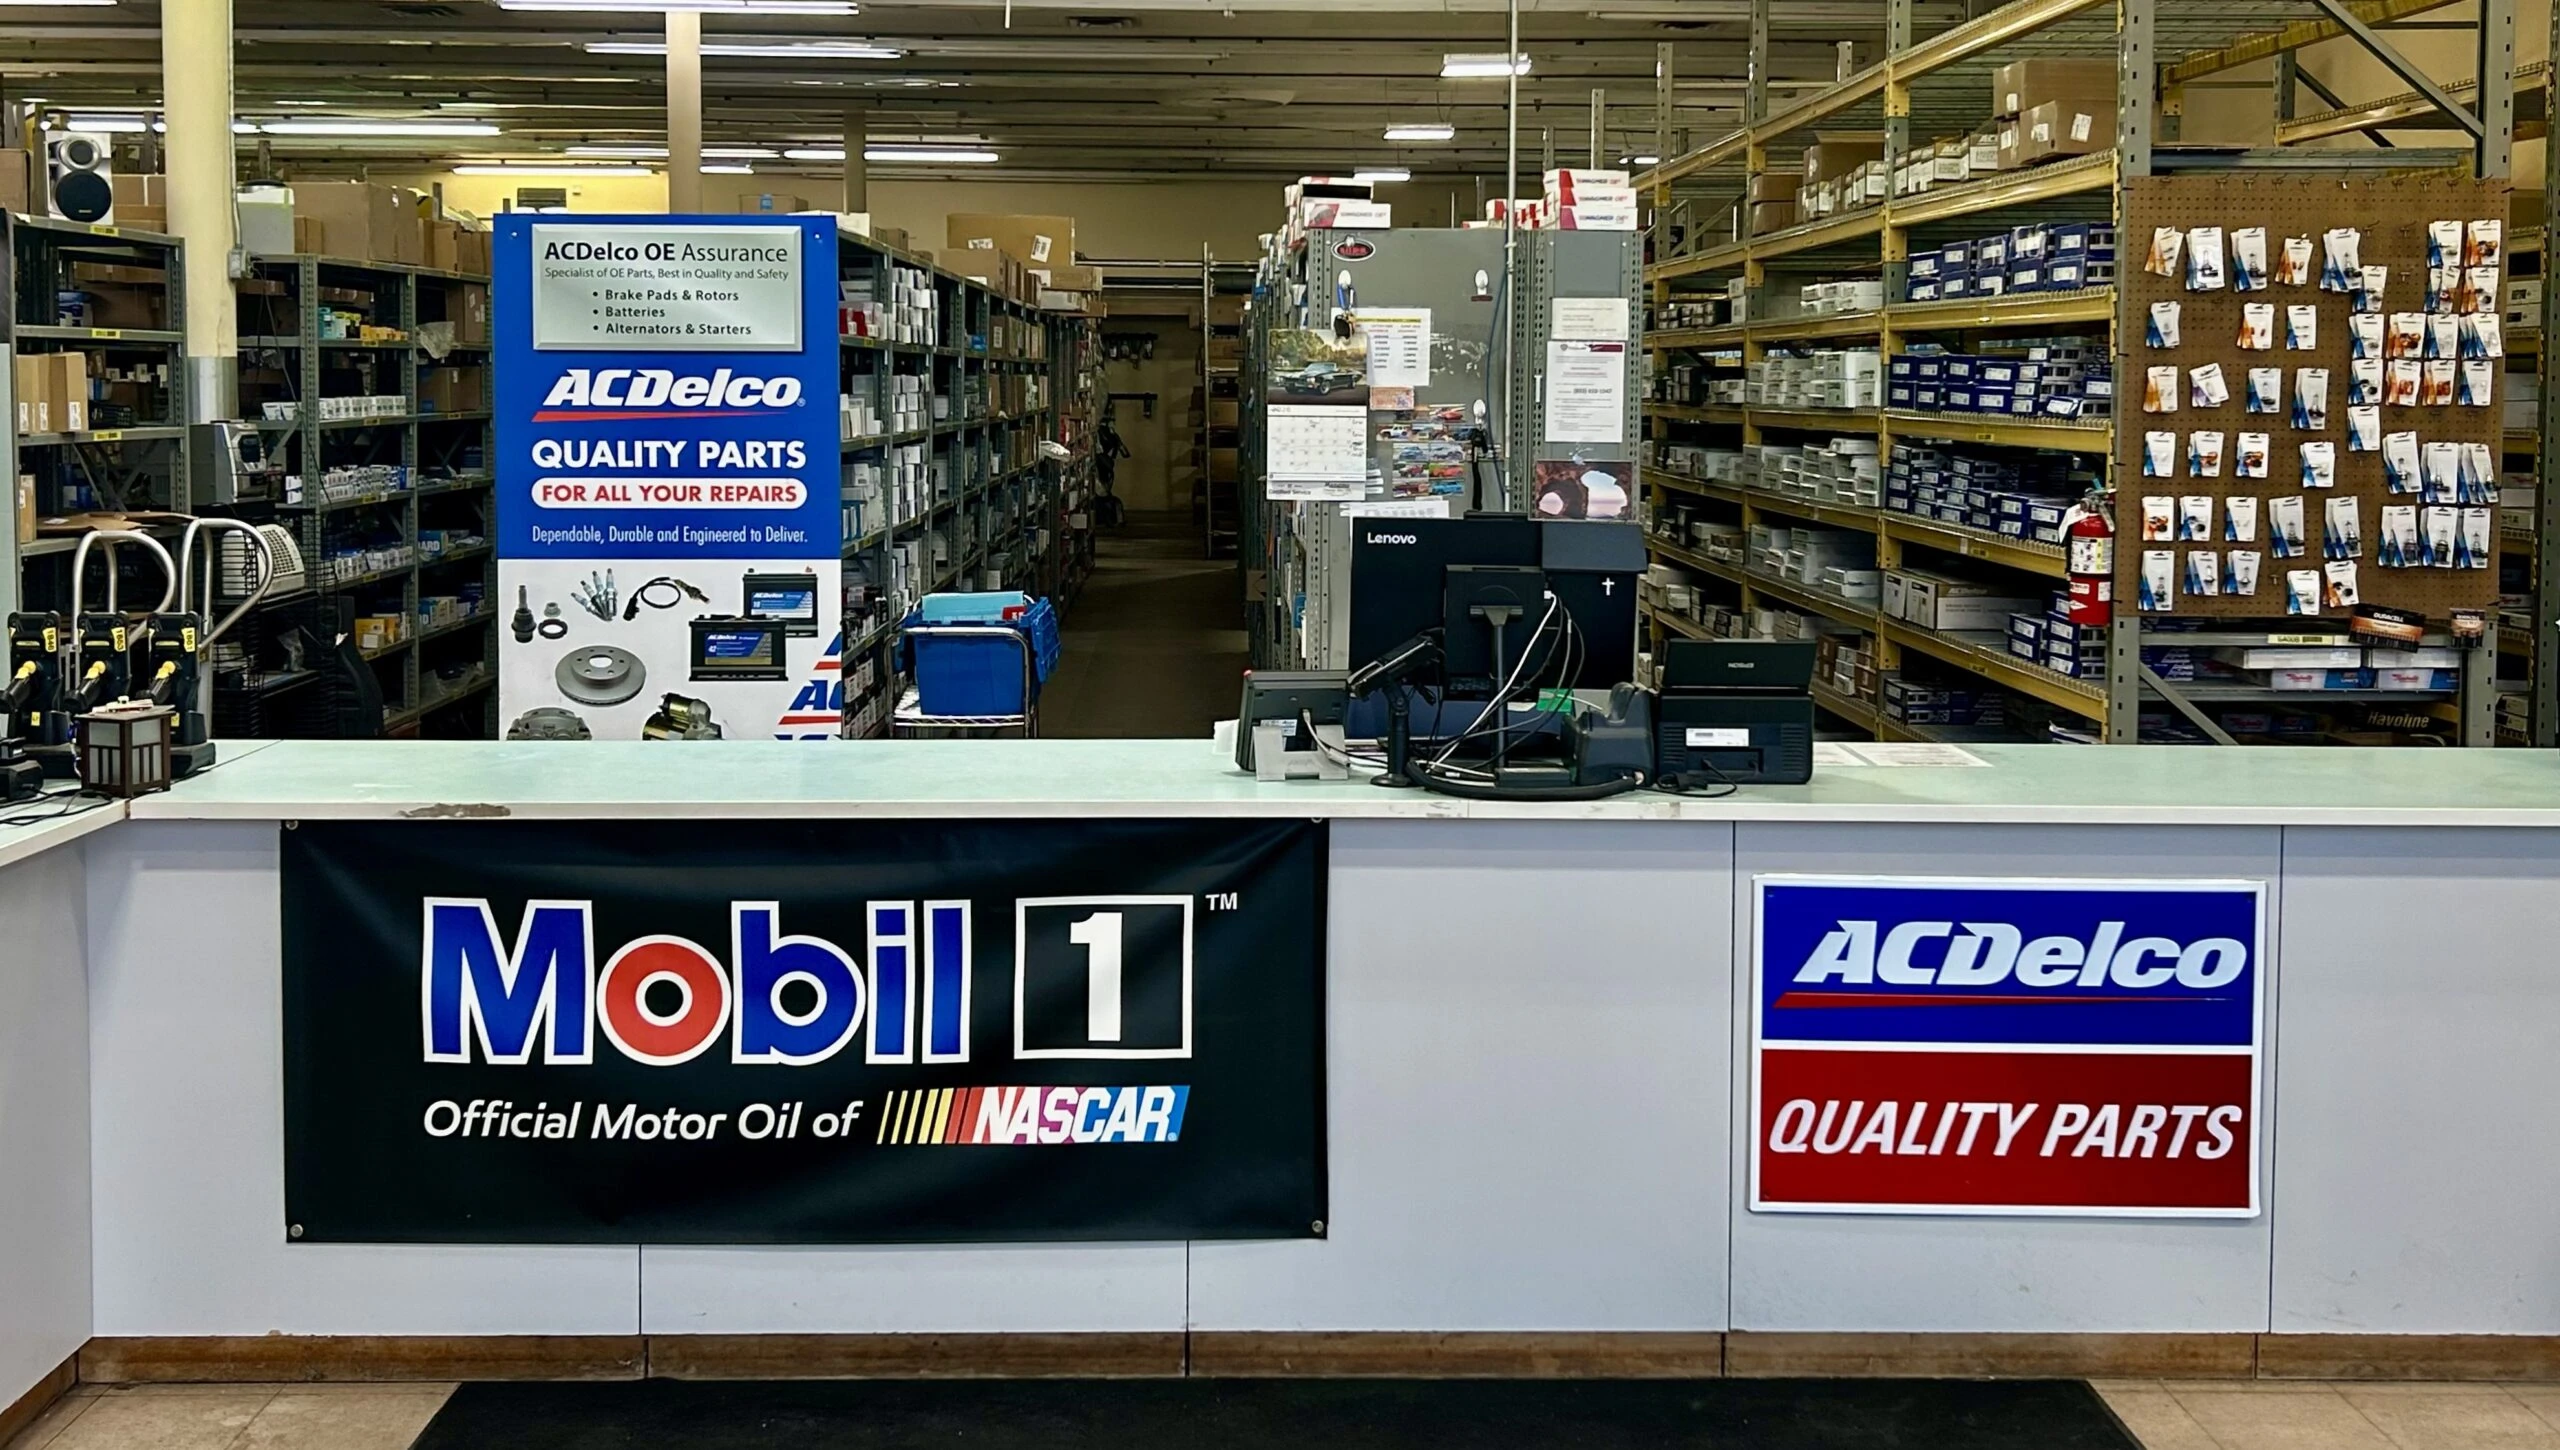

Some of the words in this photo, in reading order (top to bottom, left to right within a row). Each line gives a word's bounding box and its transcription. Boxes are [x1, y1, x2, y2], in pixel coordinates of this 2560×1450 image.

[544, 242, 639, 262] ACDelco
[644, 242, 676, 262] OE
[681, 242, 789, 263] Assurance
[544, 267, 595, 281] Specialist
[596, 267, 608, 280] of
[609, 268, 625, 280] OE
[627, 268, 656, 282] Parts,
[657, 268, 680, 281] Best
[682, 268, 693, 281] in
[694, 268, 733, 284] Quality
[734, 269, 755, 281] and
[756, 269, 789, 284] Safety
[605, 289, 643, 301] Brake
[647, 289, 678, 301] Pads
[682, 289, 692, 301] &
[695, 290, 739, 302] Rotors
[605, 306, 666, 318] Batteries
[605, 323, 681, 336] Alternators
[686, 324, 695, 336] &
[699, 324, 752, 336] Starters
[542, 368, 802, 408] ACDelco
[531, 440, 688, 469] QUALITY
[699, 440, 807, 469] PARTS
[542, 485, 586, 502] FOR
[594, 485, 632, 502] ALL
[639, 485, 702, 502] YOUR
[709, 485, 797, 503] REPAIRS
[532, 526, 605, 545] Dependable,
[609, 526, 654, 542] Durable
[656, 528, 679, 543] and
[683, 526, 747, 547] Engineered
[750, 528, 762, 543] to
[765, 527, 809, 543] Deliver.
[1367, 532, 1417, 544] Lenovo
[417, 540, 440, 552] ARD
[2373, 612, 2404, 623] DURACELL
[2367, 711, 2430, 729] Havoline
[1792, 920, 2248, 989] ACDelco
[422, 897, 972, 1067] Mobil
[1069, 911, 1123, 1042] 1
[423, 1099, 580, 1140] Official
[590, 1103, 727, 1141] Motor
[737, 1101, 803, 1140] Oil
[811, 1100, 864, 1139] of
[972, 1084, 1178, 1145] NASCAR
[1768, 1099, 2040, 1157] QUALITY
[2039, 1104, 2243, 1160] PARTS
